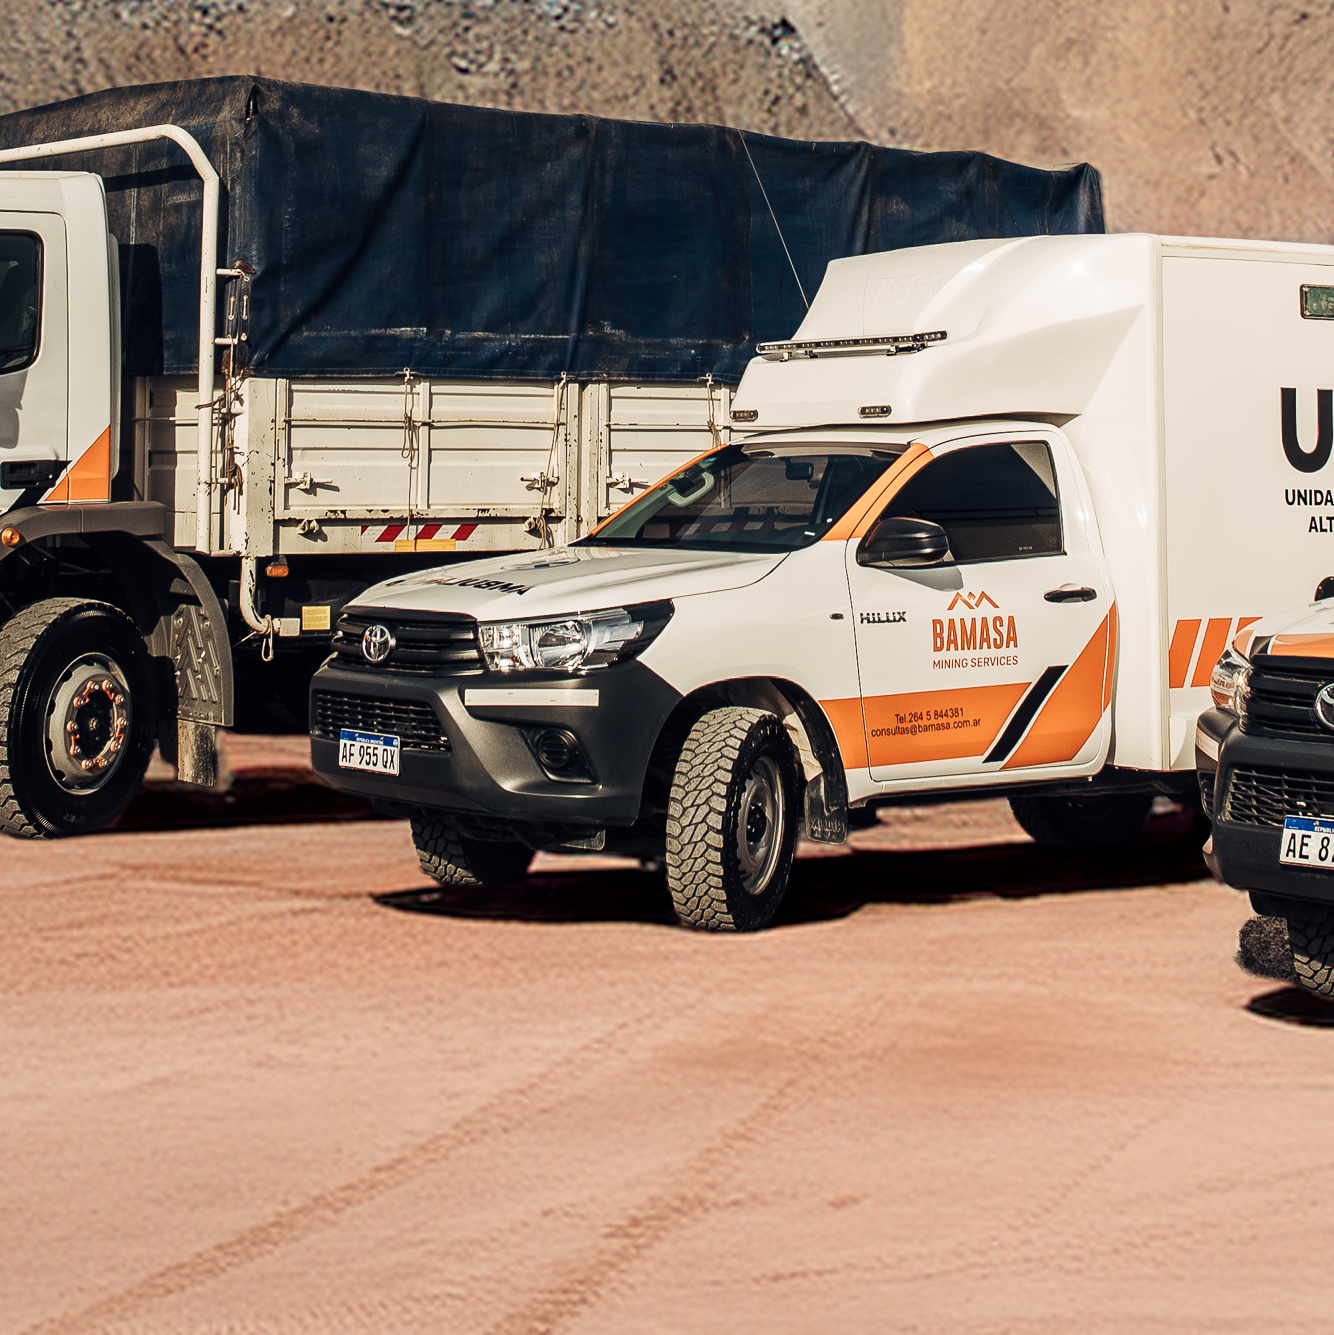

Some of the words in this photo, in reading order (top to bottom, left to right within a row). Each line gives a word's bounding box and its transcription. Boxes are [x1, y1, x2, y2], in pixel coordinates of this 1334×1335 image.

[859, 611, 907, 624] HILUX
[932, 615, 1018, 653] BAMASA
[932, 658, 968, 670] MINING
[970, 655, 1018, 668] SERVICES
[926, 710, 932, 721] 5
[933, 707, 964, 720] 844381
[871, 717, 981, 738] consultas@bamasa.com.ar
[341, 742, 356, 764] AF
[358, 745, 379, 767] 955
[382, 748, 396, 770] QX
[1285, 832, 1312, 860] AE
